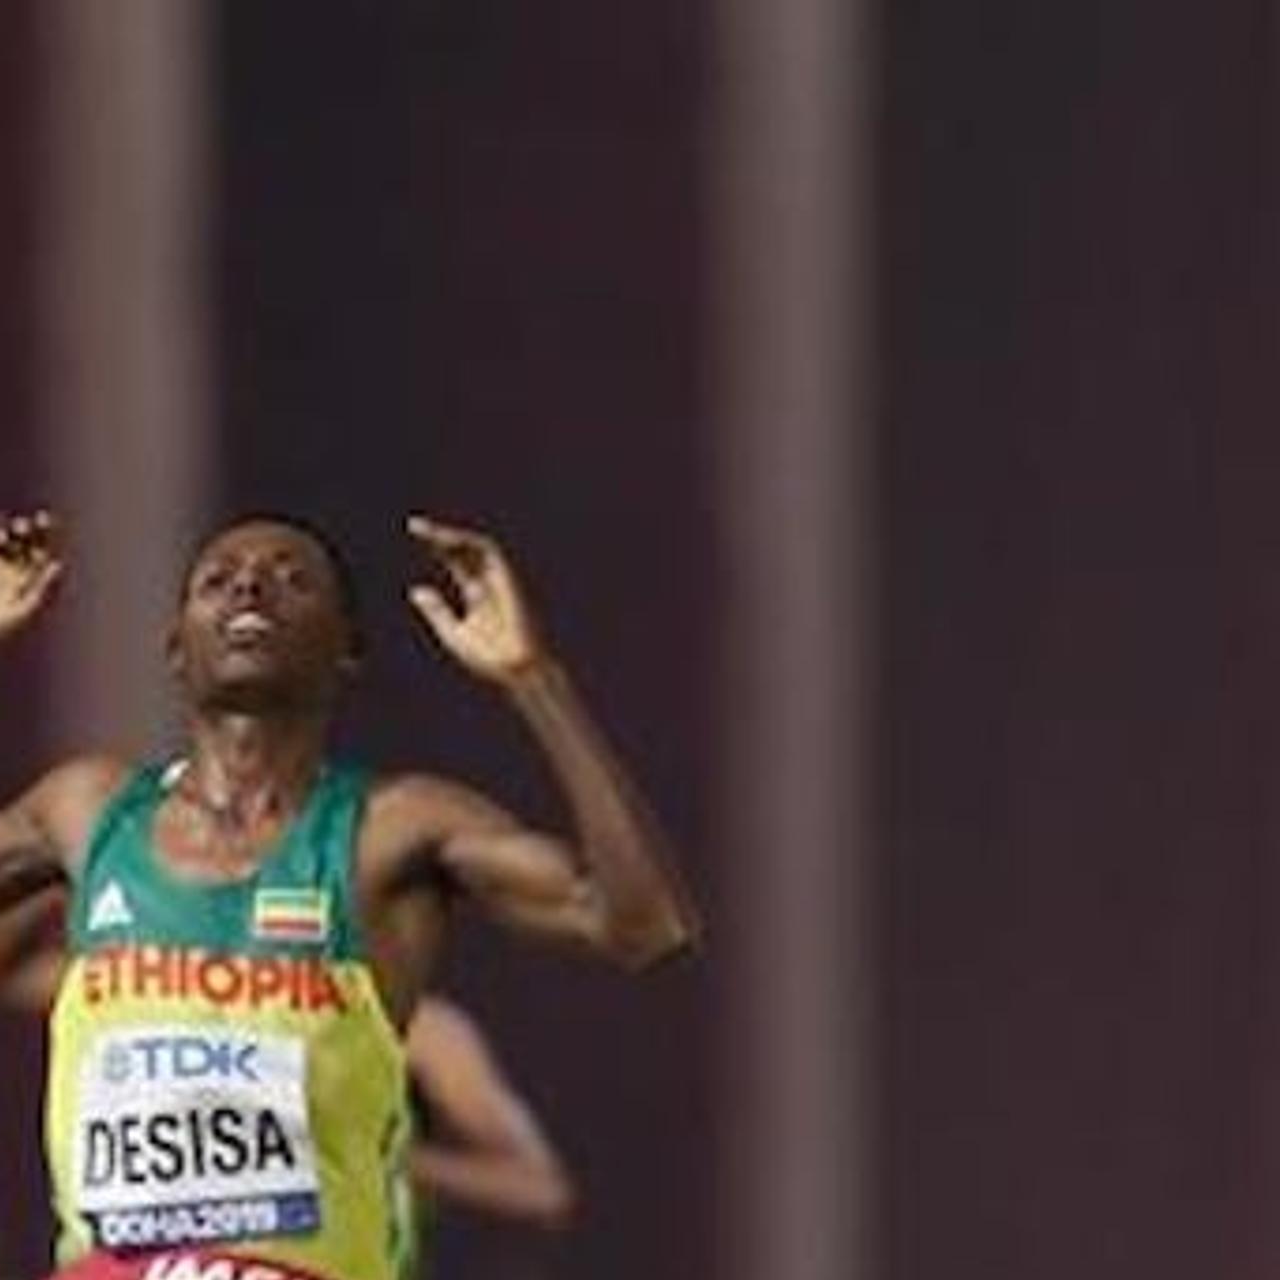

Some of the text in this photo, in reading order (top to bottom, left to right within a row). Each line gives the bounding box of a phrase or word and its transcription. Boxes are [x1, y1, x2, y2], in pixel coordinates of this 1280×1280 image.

[83, 945, 347, 1013] ETHIOPIA
[130, 1036, 262, 1082] TDK
[84, 1107, 296, 1188] DESISA
